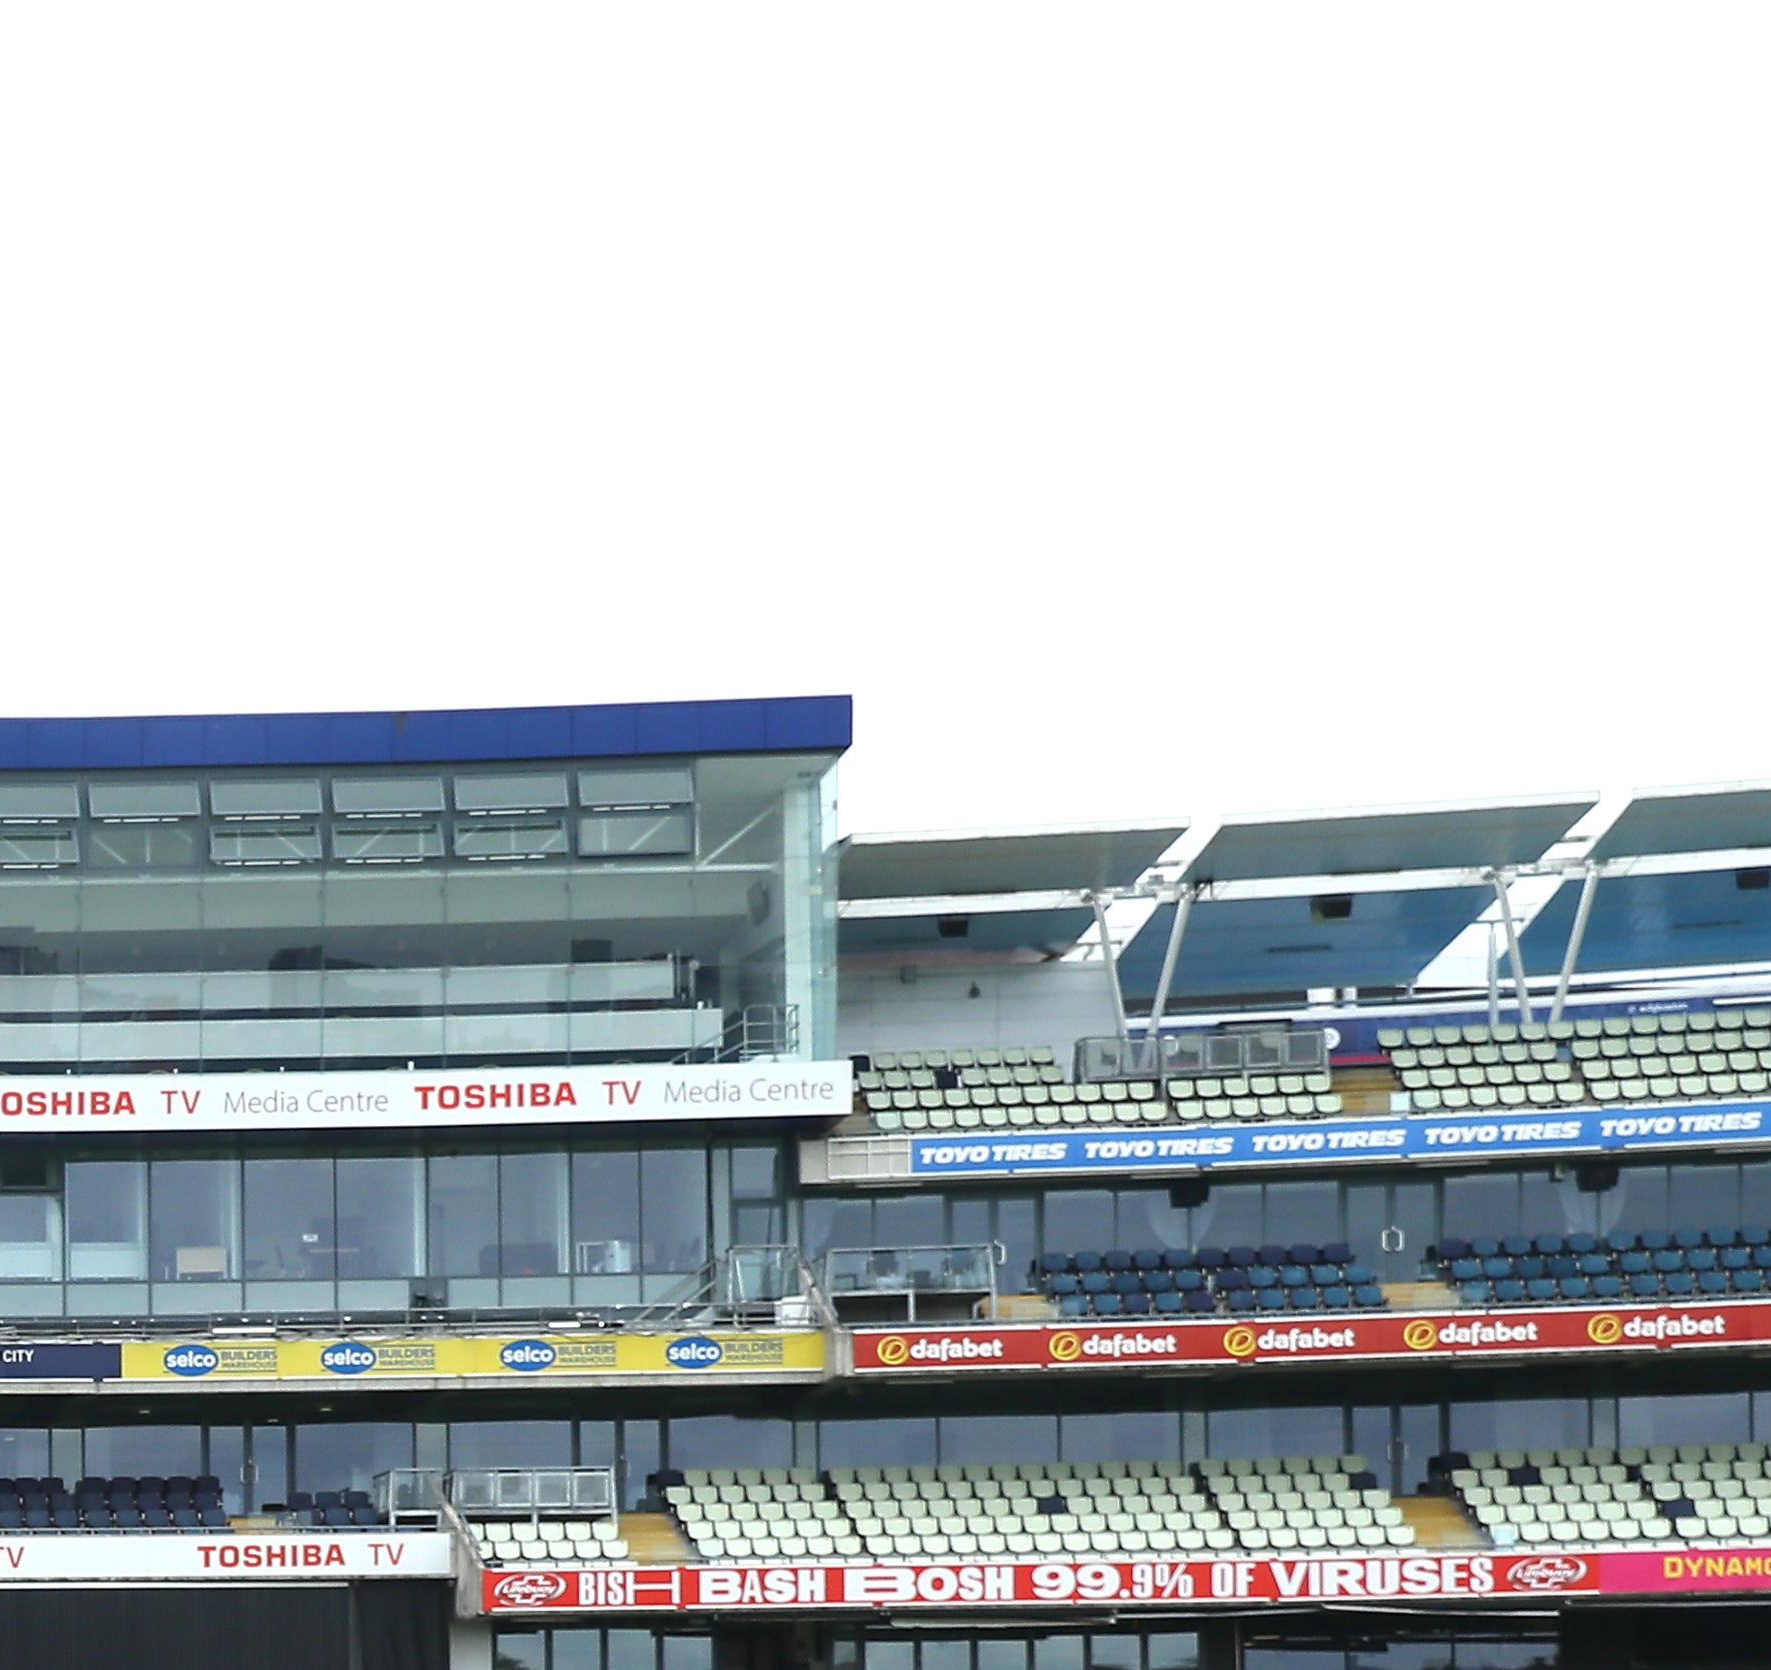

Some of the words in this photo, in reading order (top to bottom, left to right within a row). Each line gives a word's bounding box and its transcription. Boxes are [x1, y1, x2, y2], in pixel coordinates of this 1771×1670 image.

[161, 1090, 200, 1114] TV
[224, 1091, 299, 1113] Media
[306, 1090, 389, 1113] Centre
[415, 1082, 577, 1110] TOSHIBA
[602, 1080, 641, 1104] TV
[665, 1081, 741, 1103] Media
[749, 1079, 834, 1102] Centre
[1424, 1124, 1499, 1144] TOYO
[1500, 1121, 1582, 1141] TIRES
[1600, 1116, 1676, 1137] TOYO
[1678, 1111, 1762, 1132] TIRES
[1085, 1140, 1155, 1159] TOYO
[1156, 1137, 1234, 1156] TIRES
[1252, 1133, 1325, 1152] TOYO
[1327, 1129, 1407, 1149] TIRES
[920, 1145, 989, 1164] TOYO
[992, 1143, 1068, 1162] TIRES
[1438, 1320, 1539, 1347] dafabet
[1622, 1313, 1726, 1340] dafabet
[909, 1335, 1004, 1362] dafabet
[1081, 1331, 1177, 1358] dafabet
[1257, 1326, 1356, 1353] dafabet
[2, 1350, 34, 1363] CITY
[166, 1352, 217, 1369] selco
[221, 1351, 278, 1361] BUILDERS
[323, 1350, 374, 1367] selco
[379, 1349, 435, 1360] BUILDERS
[503, 1347, 554, 1364] selco
[668, 1344, 720, 1361] selco
[198, 1544, 346, 1568] TOSHIBA
[368, 1543, 405, 1566] TV
[501, 1582, 559, 1597] Lifebuoy
[578, 1570, 680, 1606] BISH
[699, 1568, 826, 1603] BASH
[844, 1564, 1014, 1602] BOSH
[1031, 1562, 1194, 1600] 99.9%
[1211, 1561, 1254, 1598] OF
[1268, 1556, 1495, 1597] VIRUSES
